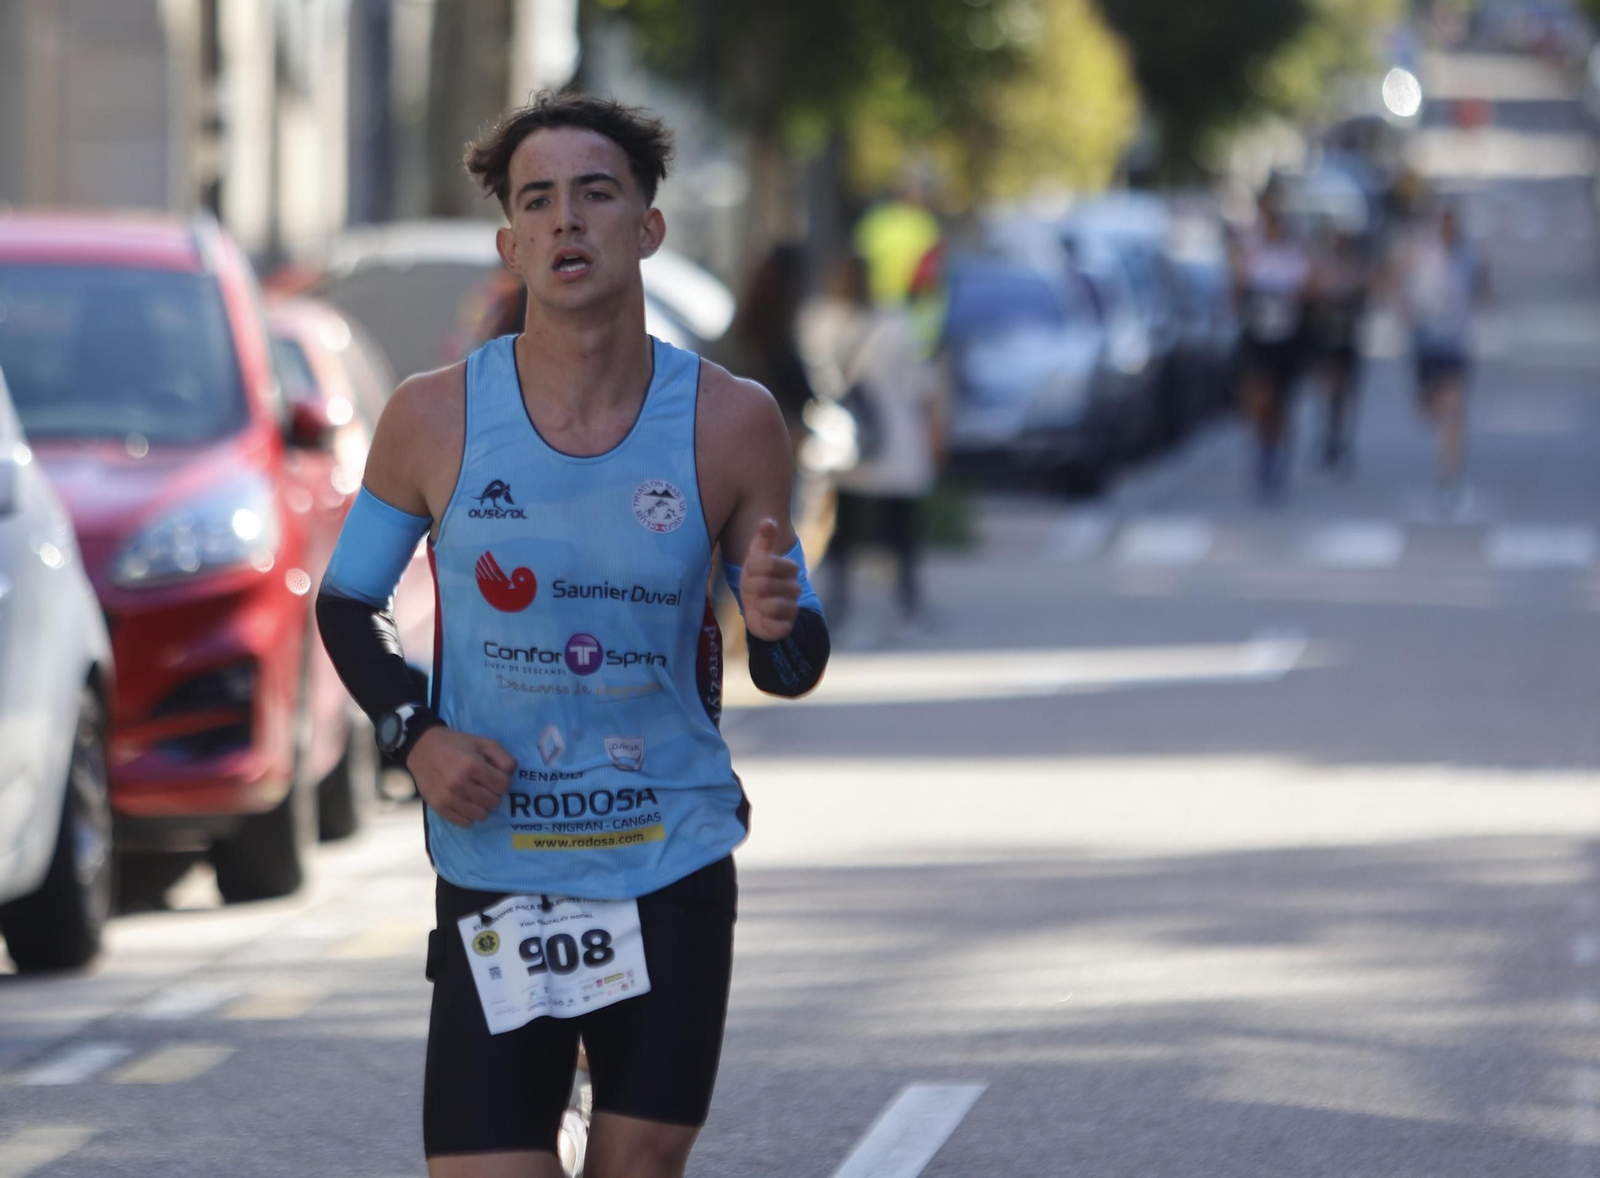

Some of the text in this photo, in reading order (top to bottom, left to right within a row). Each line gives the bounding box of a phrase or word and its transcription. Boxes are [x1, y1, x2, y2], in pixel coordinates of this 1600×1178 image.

[552, 580, 682, 606] Saunier Duval
[518, 770, 584, 782] RENAULT
[508, 787, 658, 819] RODOSA
[511, 823, 543, 832] VIGO
[612, 811, 662, 830] CANGAS
[534, 832, 644, 848] www.rodosa.com
[518, 928, 616, 976] 908
